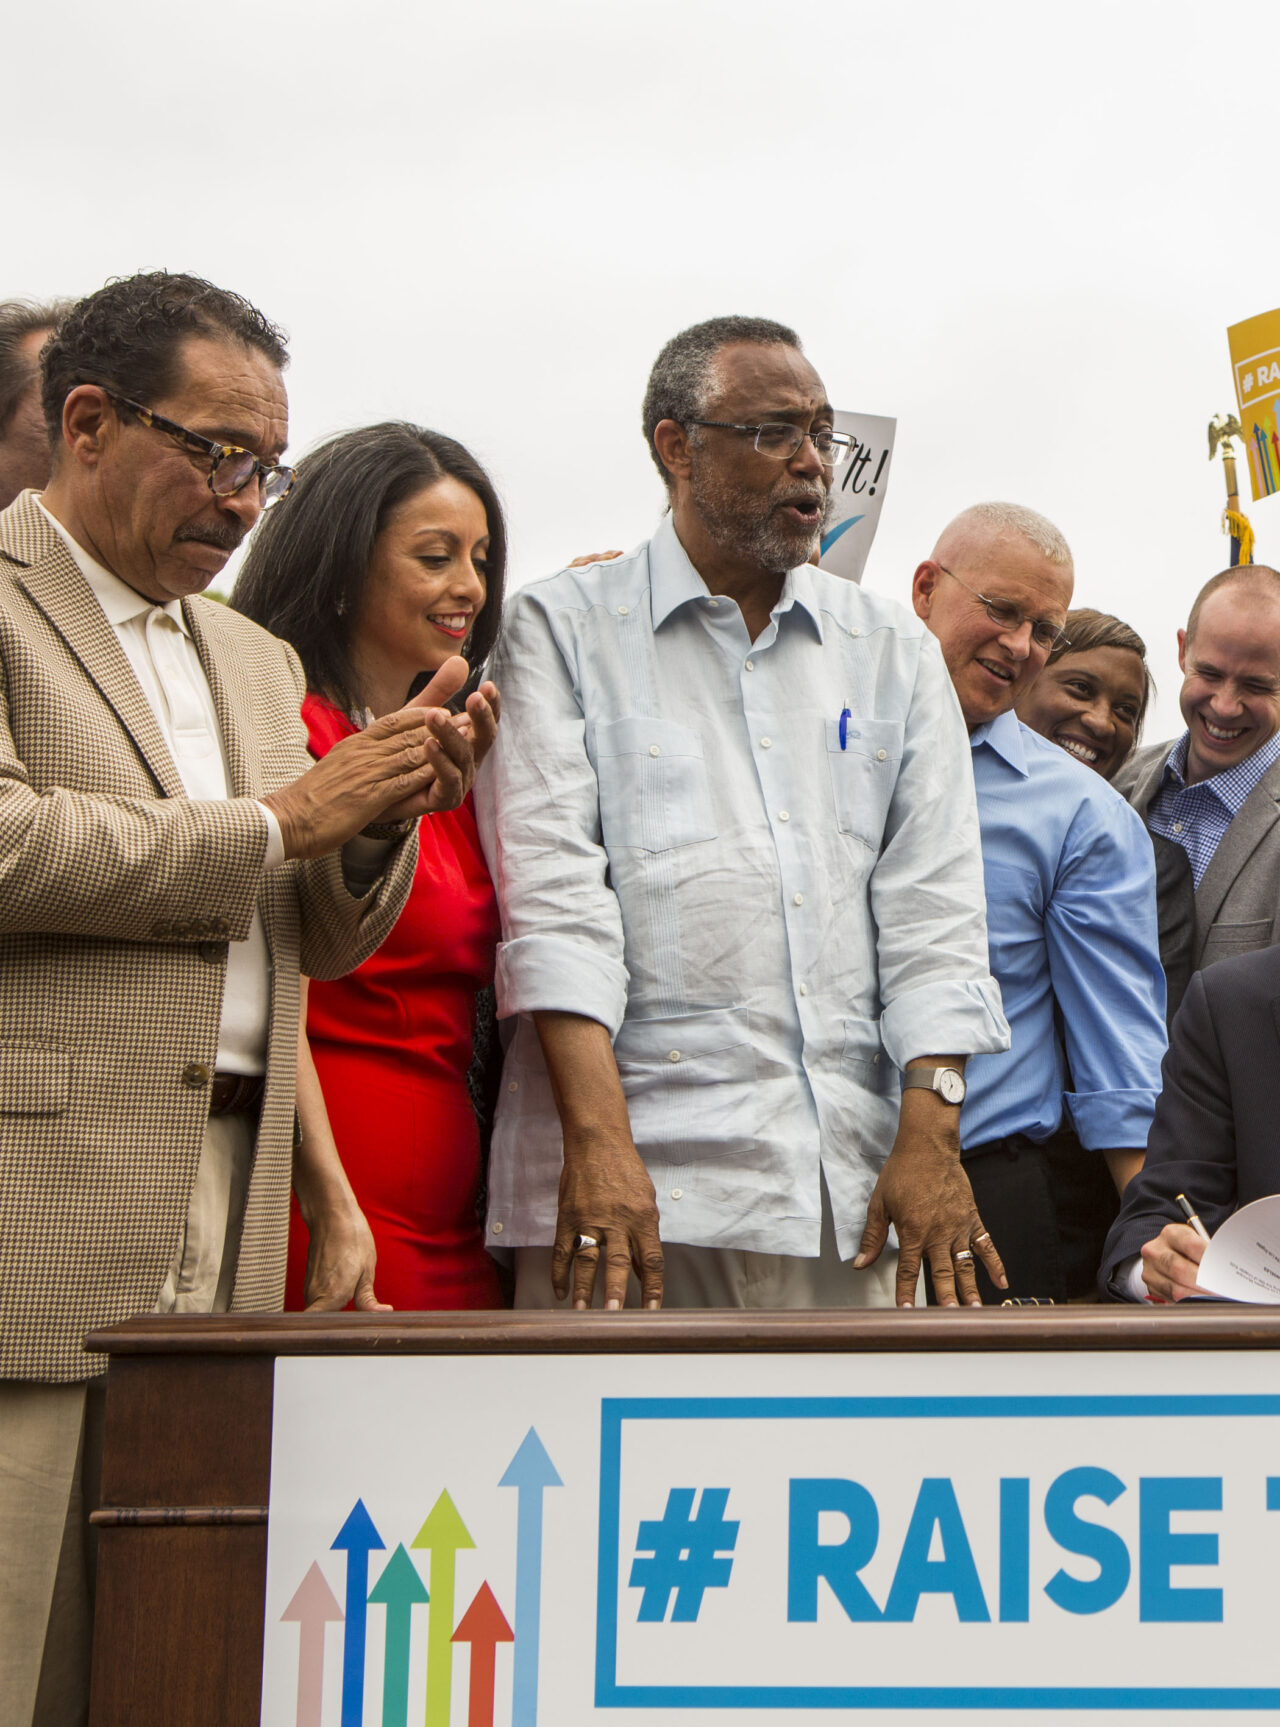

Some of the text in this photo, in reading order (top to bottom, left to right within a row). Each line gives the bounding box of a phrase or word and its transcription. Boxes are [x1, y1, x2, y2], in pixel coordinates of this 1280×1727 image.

[1242, 372, 1254, 393] #
[842, 443, 889, 497] It!
[628, 1487, 740, 1623] #
[787, 1465, 1223, 1623] RAISE
